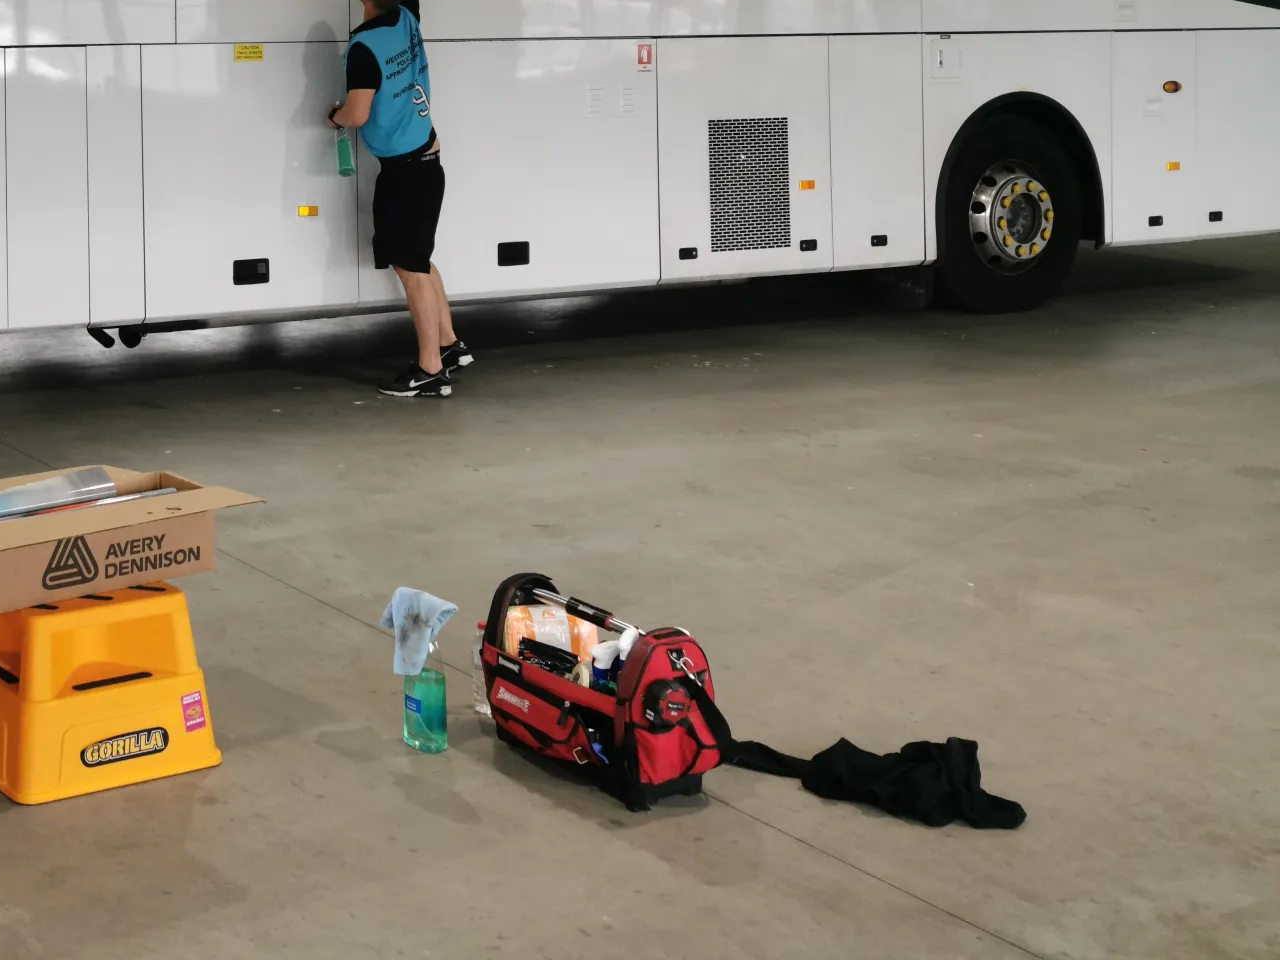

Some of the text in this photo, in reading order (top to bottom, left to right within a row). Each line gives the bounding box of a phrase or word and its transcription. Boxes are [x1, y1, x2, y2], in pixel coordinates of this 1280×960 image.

[105, 534, 166, 560] AVERY
[105, 546, 201, 579] DENNISON
[84, 729, 165, 764] GORILLA
